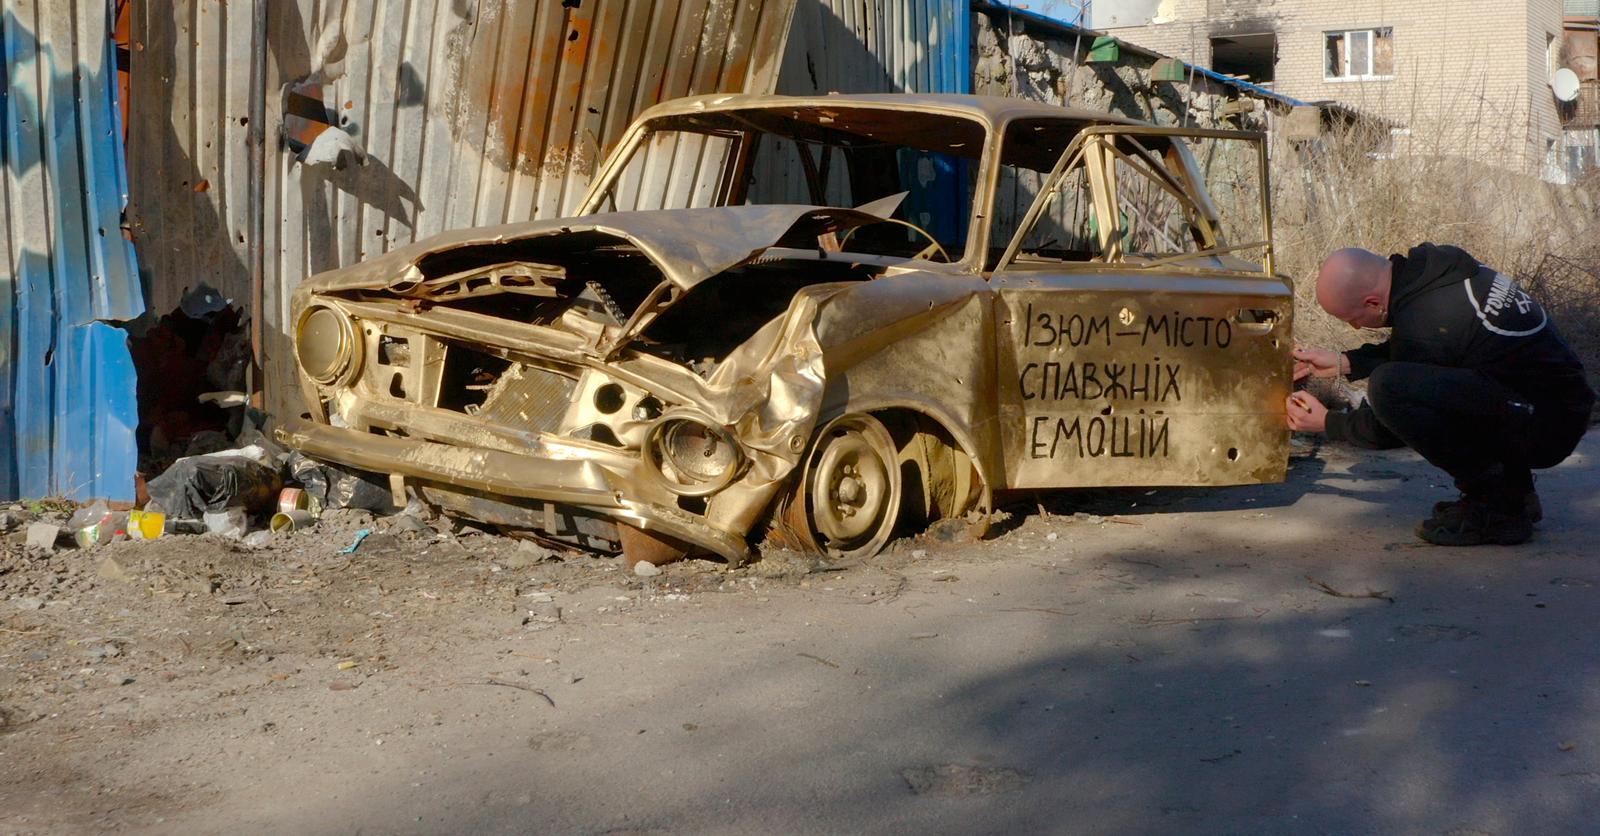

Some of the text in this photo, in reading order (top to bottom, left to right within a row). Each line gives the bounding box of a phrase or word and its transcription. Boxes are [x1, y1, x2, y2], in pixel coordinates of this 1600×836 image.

[1024, 303, 1110, 347] ІЗЮМ
[1141, 312, 1231, 348] МІСТО
[1031, 408, 1169, 459] ЕМОЦІЙ
